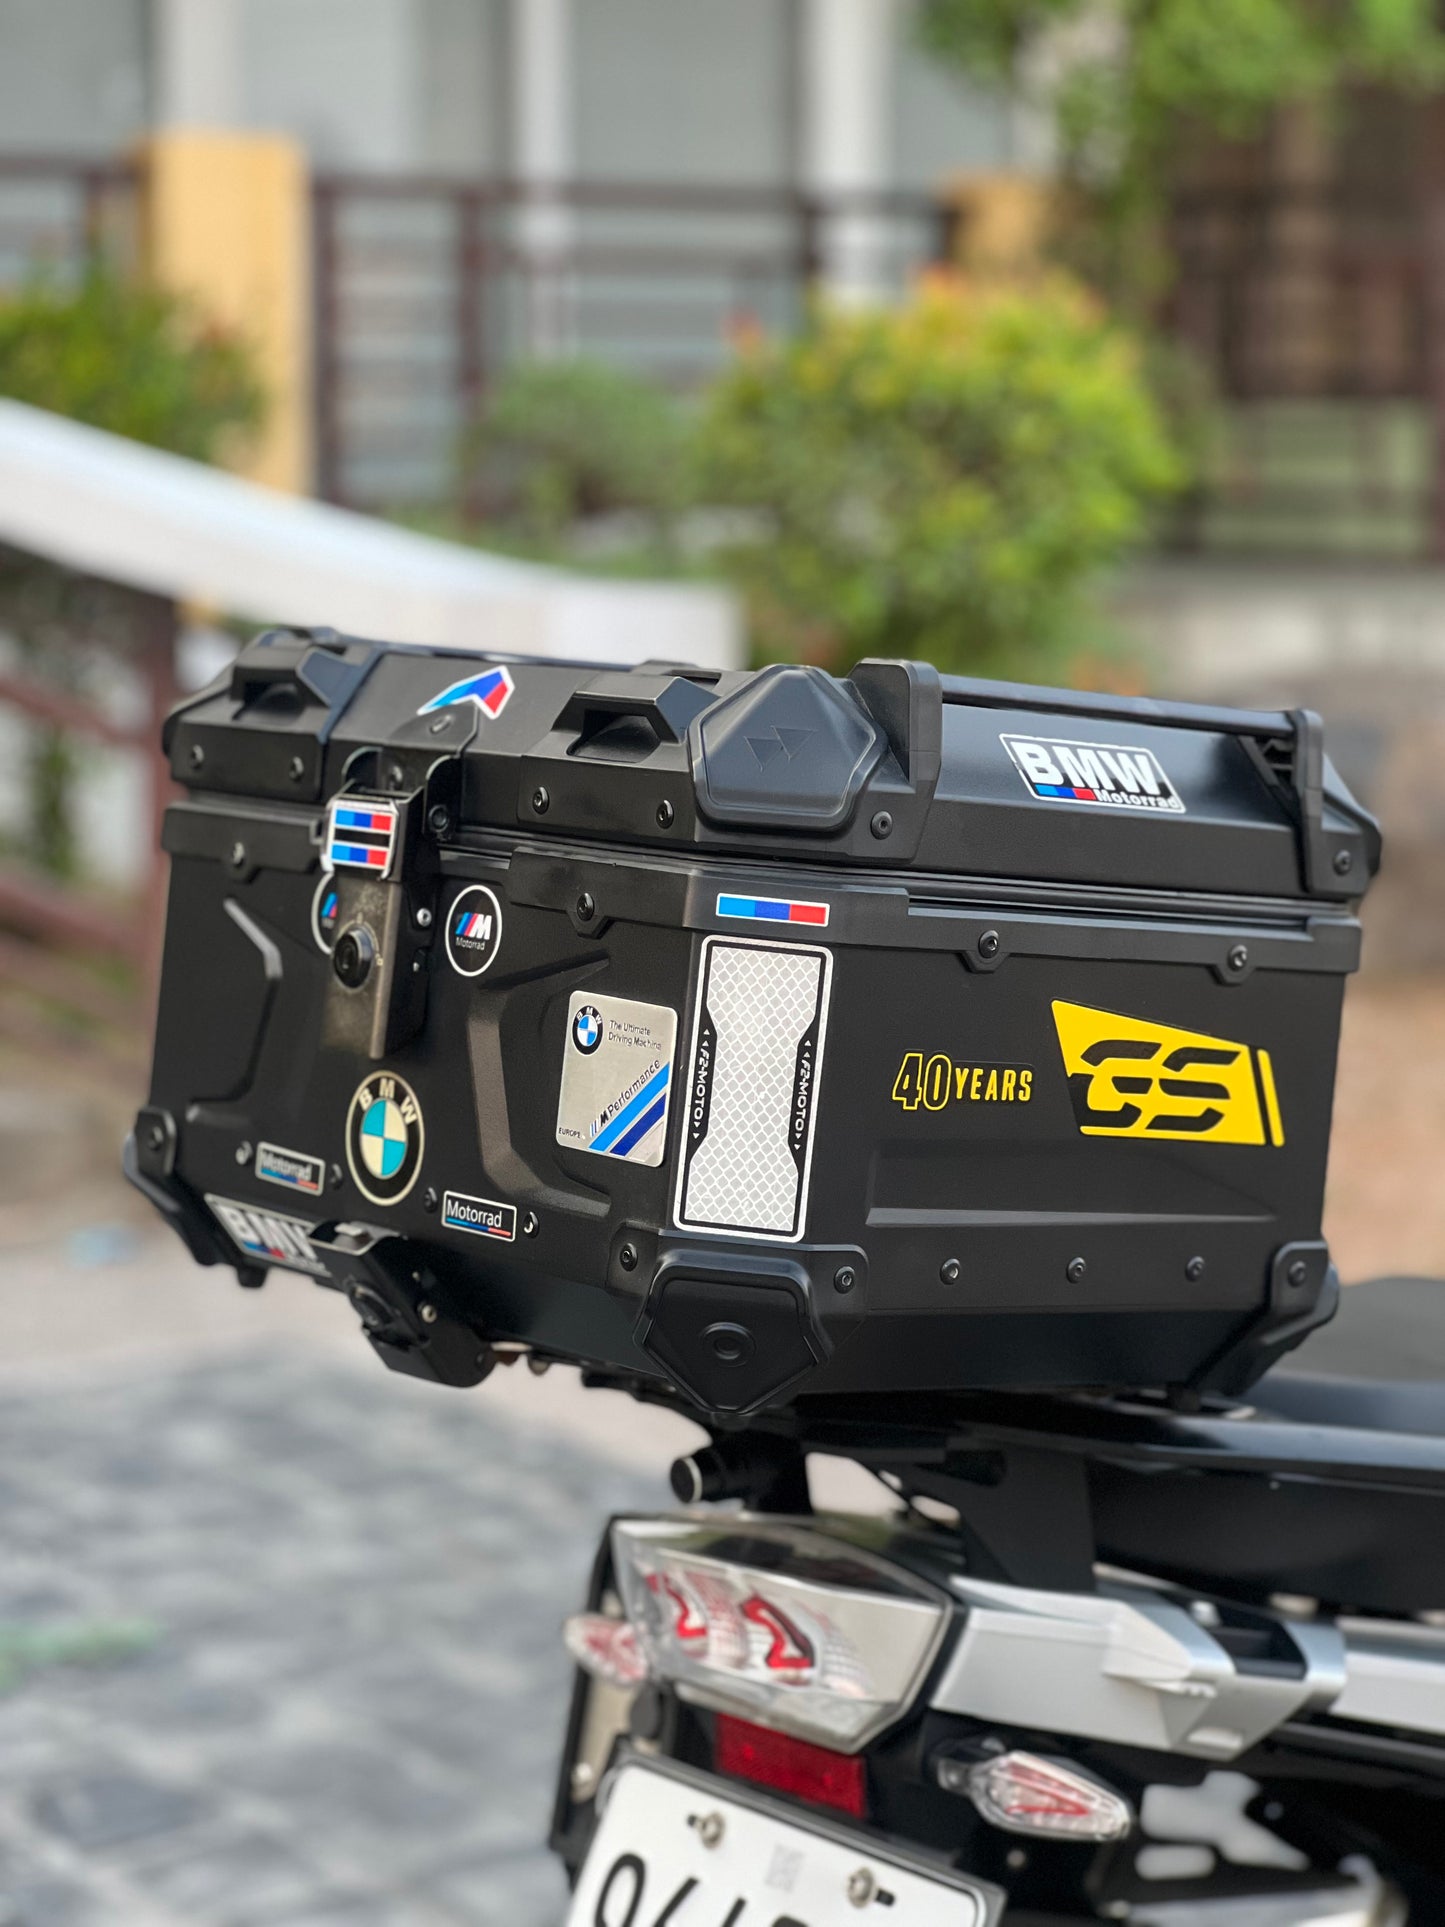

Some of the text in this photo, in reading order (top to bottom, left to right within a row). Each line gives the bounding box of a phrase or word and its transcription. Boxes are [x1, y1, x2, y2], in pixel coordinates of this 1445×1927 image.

[1010, 741, 1161, 795] BMW
[1096, 788, 1180, 810] Motorrad
[456, 937, 485, 951] Motorrad
[575, 1007, 603, 1025] BMW
[610, 1020, 651, 1036] The Ultimate
[608, 1032, 633, 1047] Driving
[694, 1047, 710, 1121] F2-MOTO
[795, 1059, 811, 1132] F2-MOTO
[893, 1053, 1033, 1111] 40 YEARS
[359, 1077, 418, 1125] BMW
[262, 1150, 312, 1181] Motorrad
[446, 1199, 503, 1228] Motorrad
